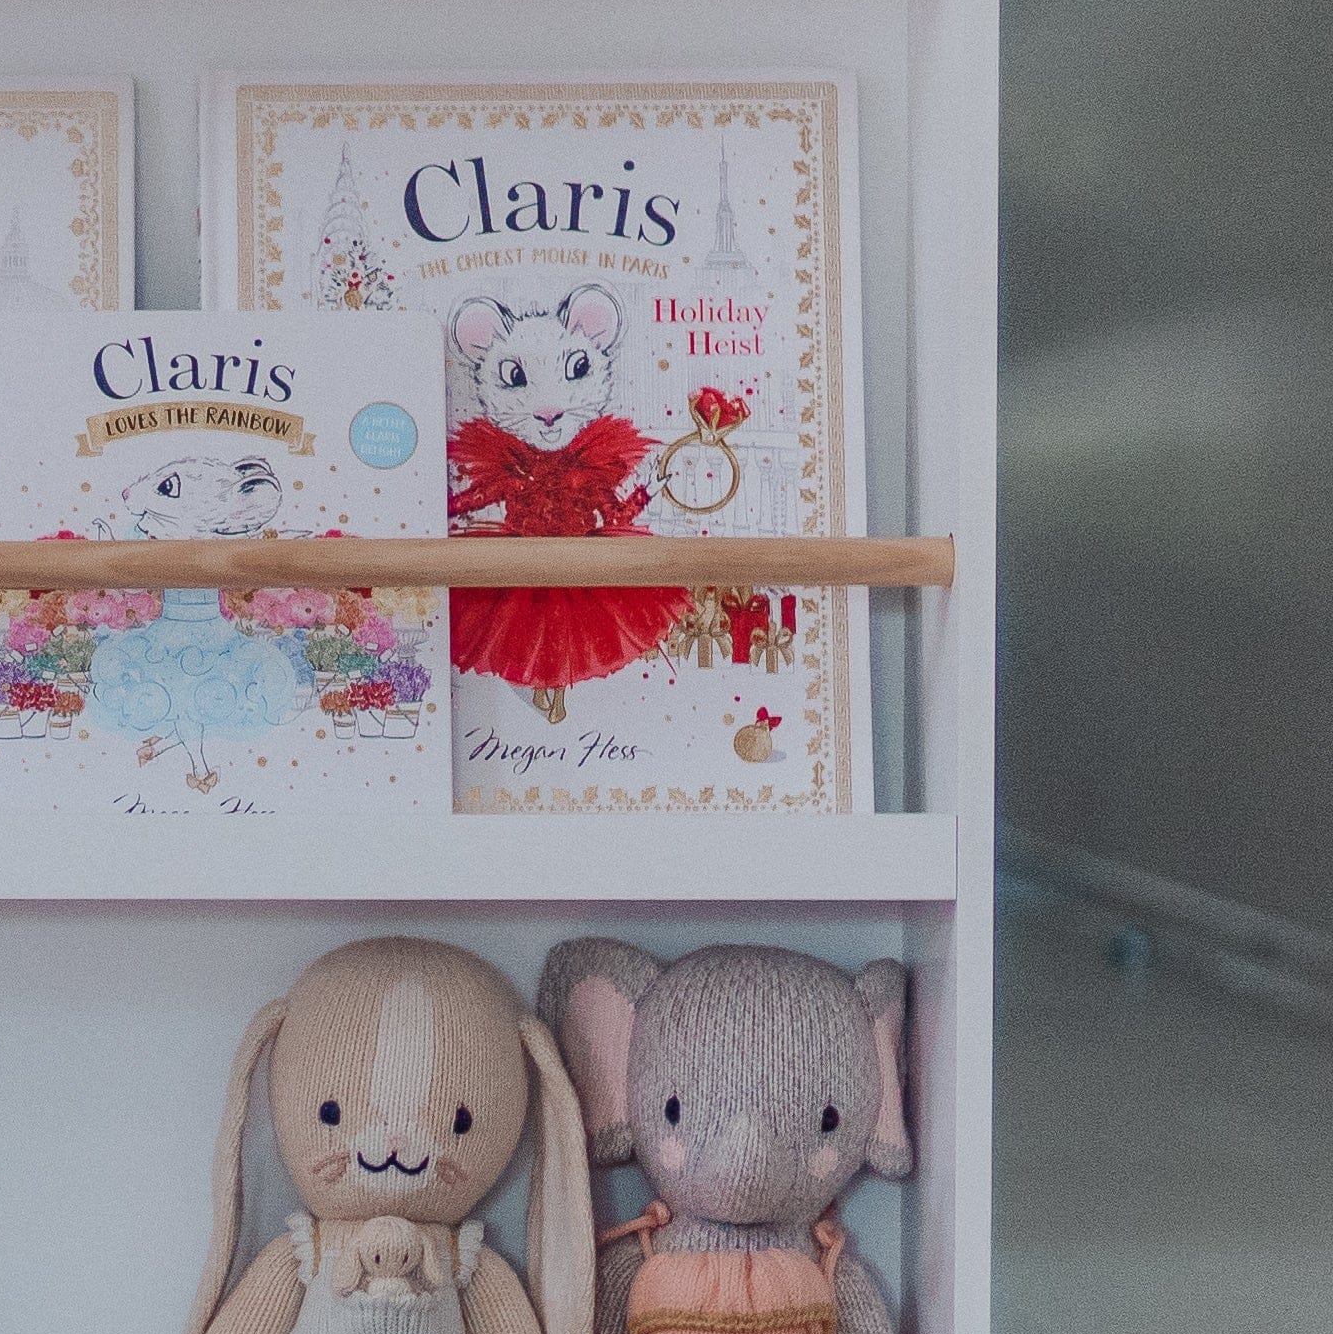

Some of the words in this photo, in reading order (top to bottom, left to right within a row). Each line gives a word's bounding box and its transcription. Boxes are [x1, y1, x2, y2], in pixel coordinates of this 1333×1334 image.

[403, 156, 681, 246] Claris
[418, 258, 449, 279] THE
[532, 247, 589, 265] MOUSE
[598, 252, 616, 269] IN
[622, 255, 670, 280] PARIS
[653, 297, 771, 330] Holiday
[688, 331, 766, 356] Heist
[93, 335, 297, 403] Claris
[105, 411, 158, 436] LOVES
[164, 407, 202, 425] THE
[206, 406, 292, 436] RAINBOW
[465, 727, 566, 775] Megan
[577, 730, 653, 768] Hess
